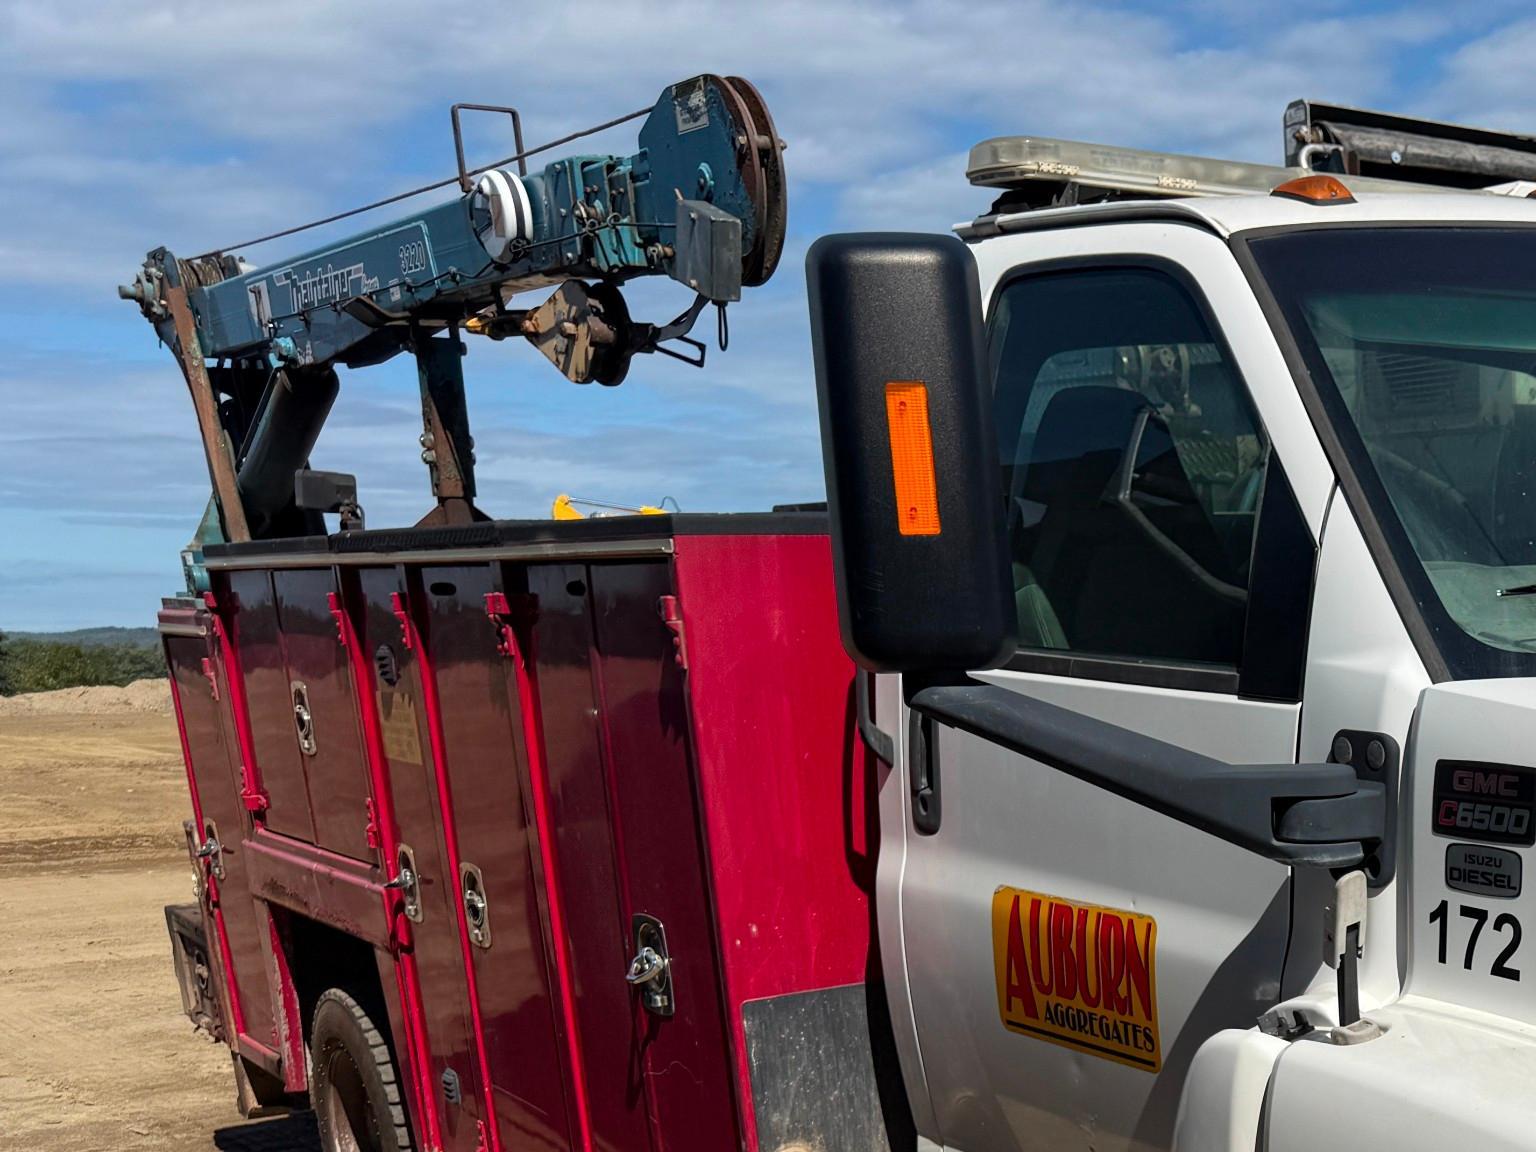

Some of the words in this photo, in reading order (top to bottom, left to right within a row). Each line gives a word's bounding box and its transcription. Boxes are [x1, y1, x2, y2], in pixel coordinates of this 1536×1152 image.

[1452, 769, 1520, 797] GMC
[1438, 800, 1530, 835] C6500
[1464, 852, 1503, 868] ISUZU
[1449, 866, 1518, 891] DIESEL
[1006, 894, 1153, 1022] AUBURN
[1429, 899, 1522, 982] 172
[1043, 1000, 1155, 1053] AGGREGATES
